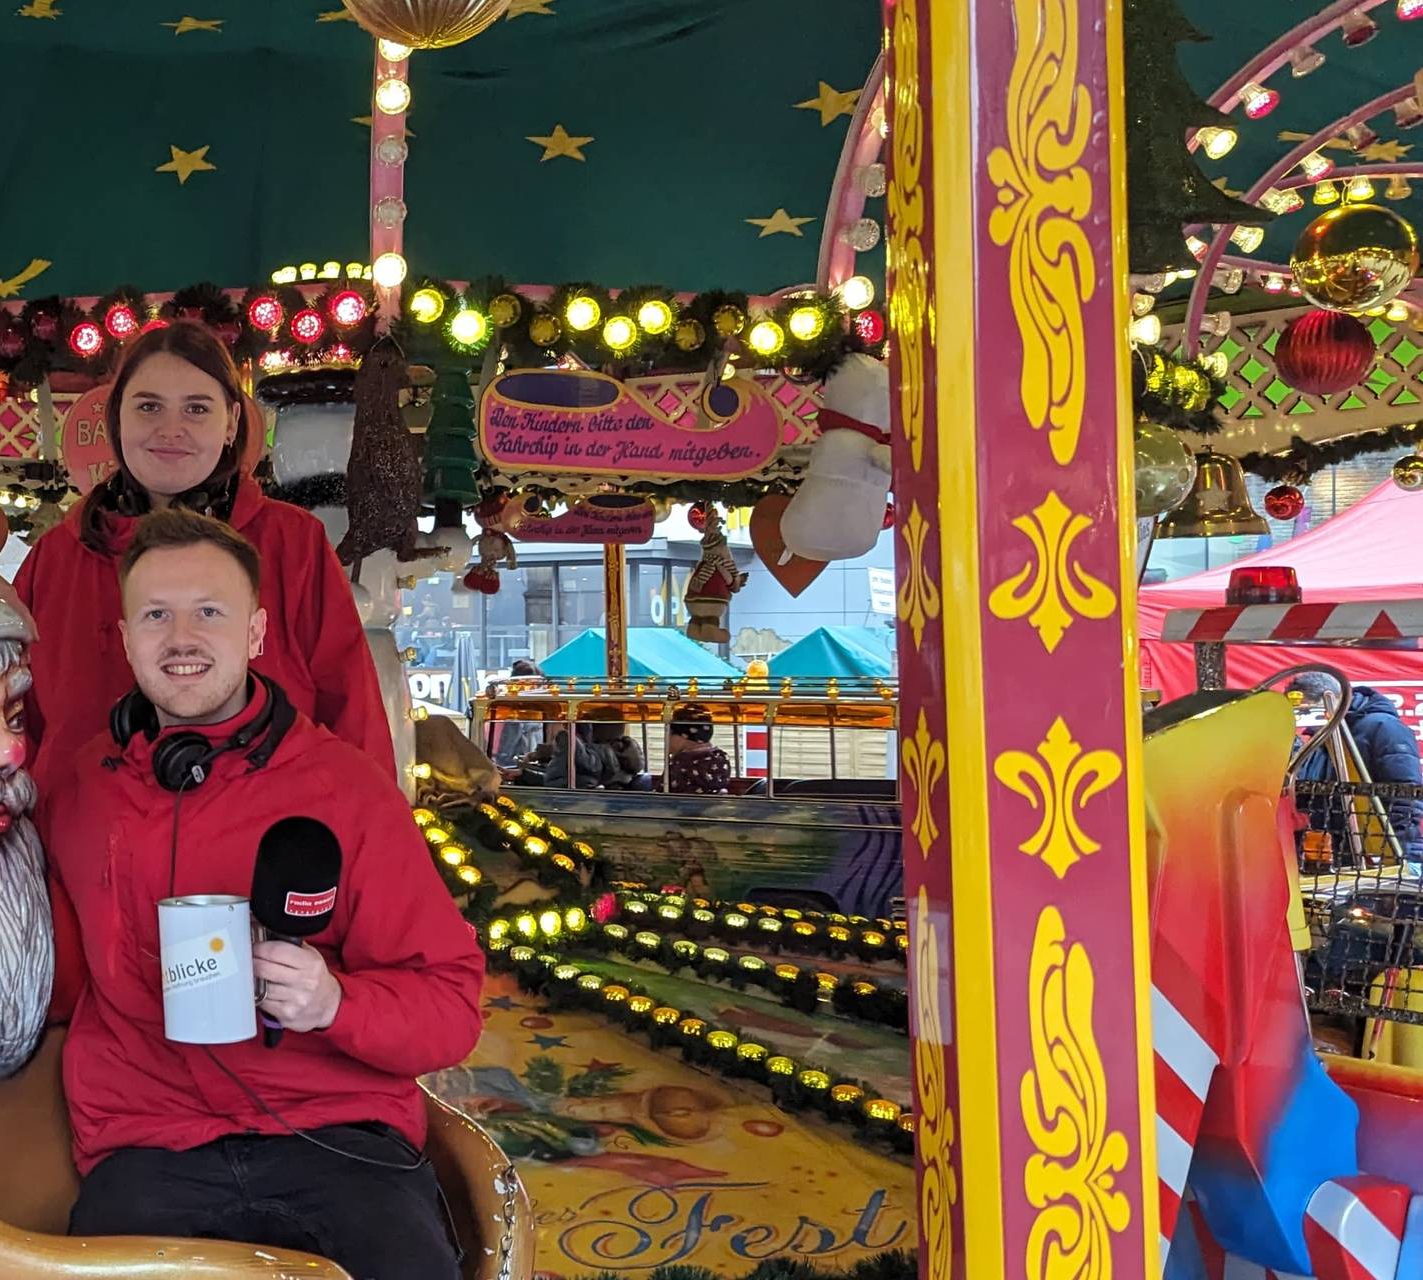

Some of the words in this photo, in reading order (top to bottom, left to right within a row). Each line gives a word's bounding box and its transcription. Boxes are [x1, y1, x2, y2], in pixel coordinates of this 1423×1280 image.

[490, 408, 518, 429] Den
[521, 412, 583, 433] Kindern
[588, 412, 622, 432] bitte
[625, 414, 654, 430] den
[493, 431, 558, 460] Fahrchip
[564, 437, 582, 456] in
[585, 442, 613, 457] der
[613, 441, 664, 464] Hand
[669, 440, 760, 467] mitgeben.
[165, 958, 218, 984] blicke
[558, 1182, 907, 1270] Fest
